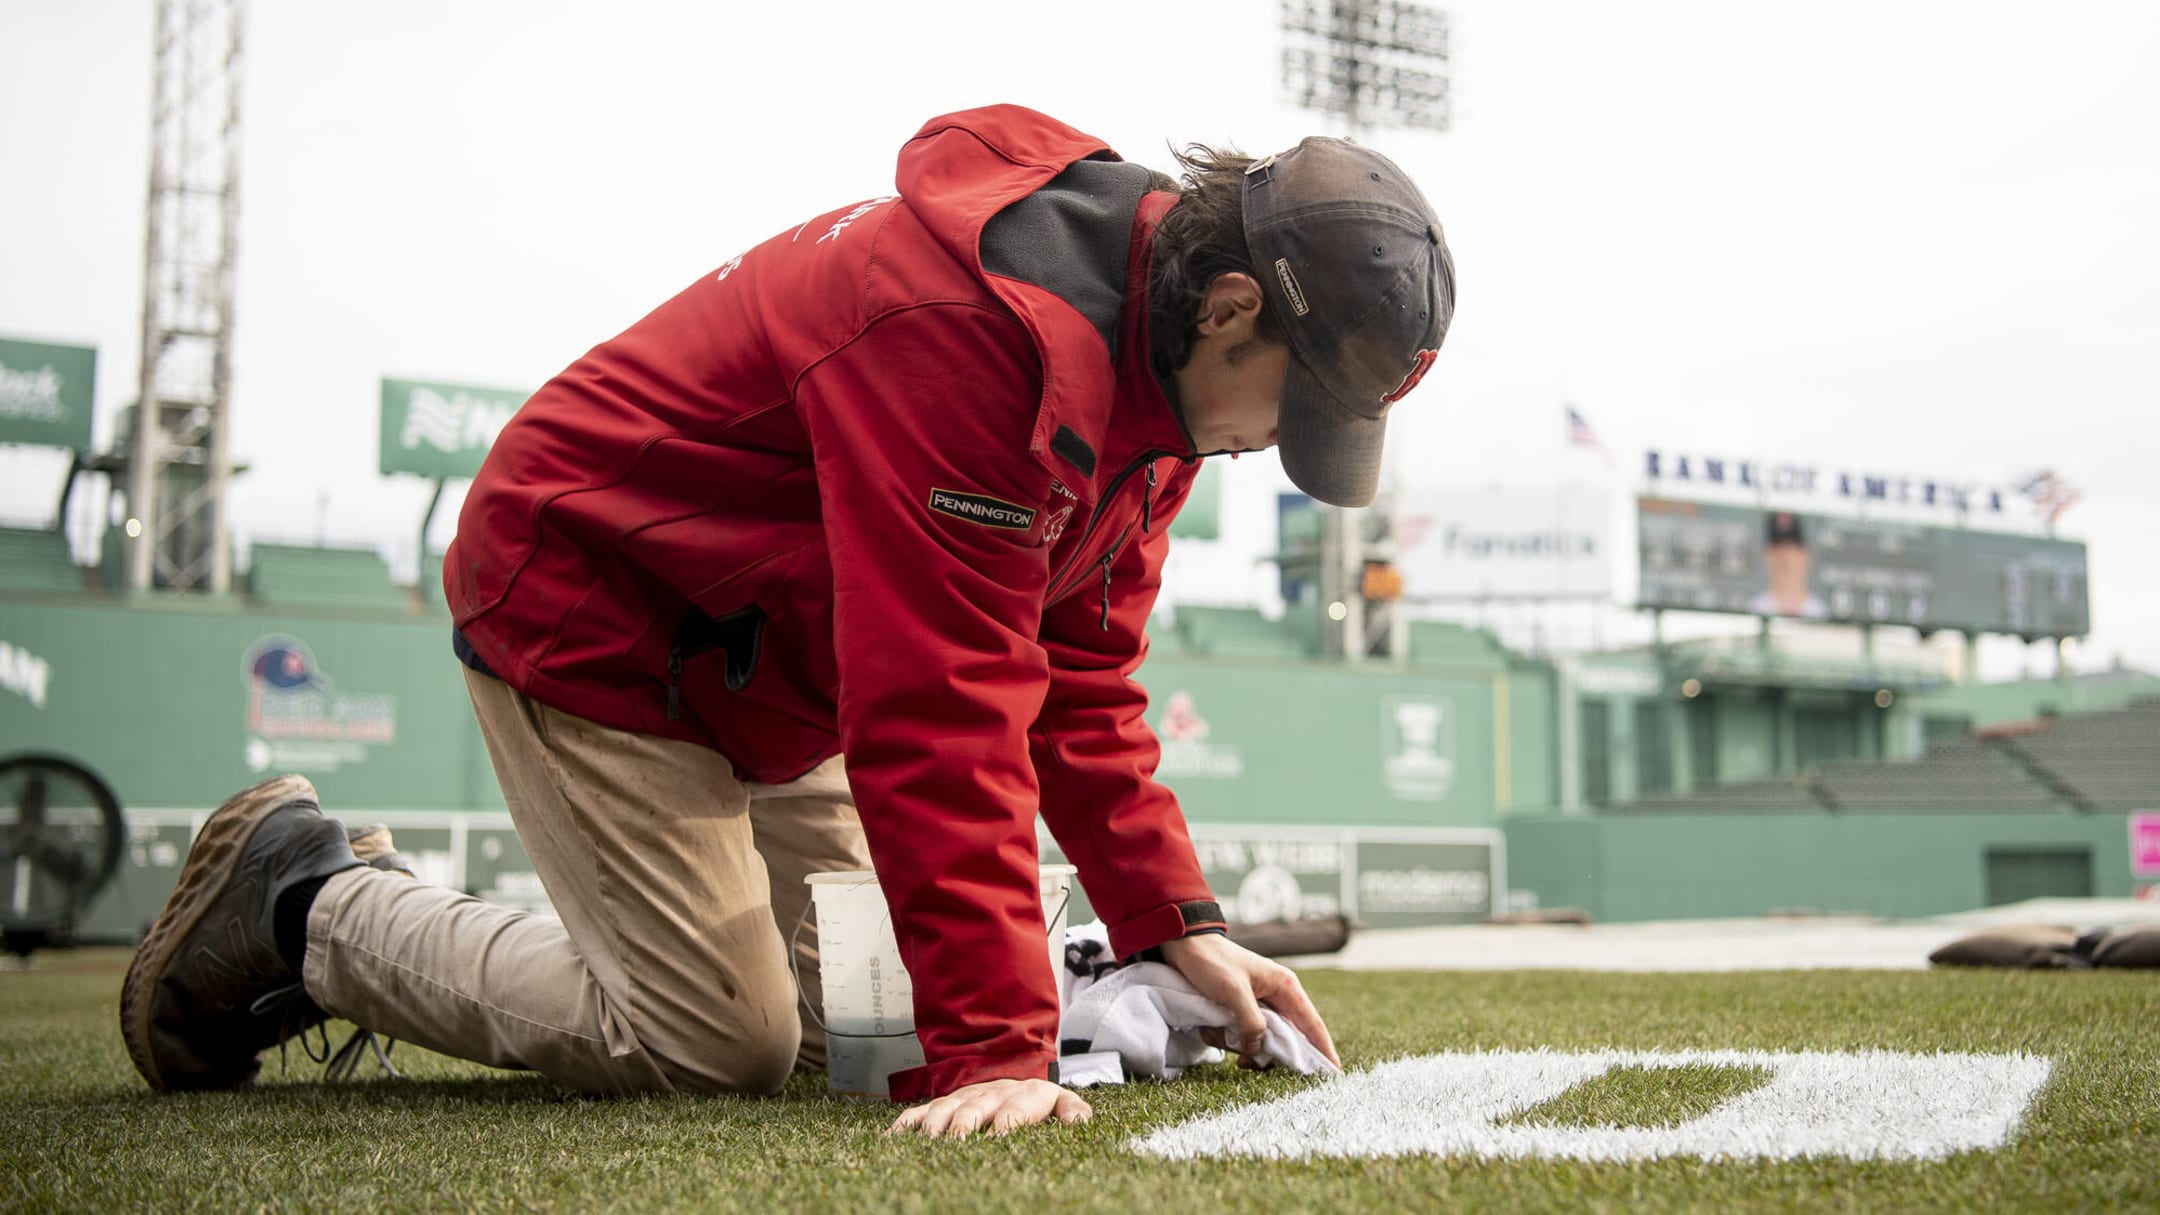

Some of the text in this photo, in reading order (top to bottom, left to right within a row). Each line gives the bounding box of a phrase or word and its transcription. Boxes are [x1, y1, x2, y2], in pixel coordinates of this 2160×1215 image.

[1279, 261, 1305, 312] PENNINGTON
[933, 493, 1031, 526] PENNINGTON
[869, 956, 885, 1034] OUNCES
